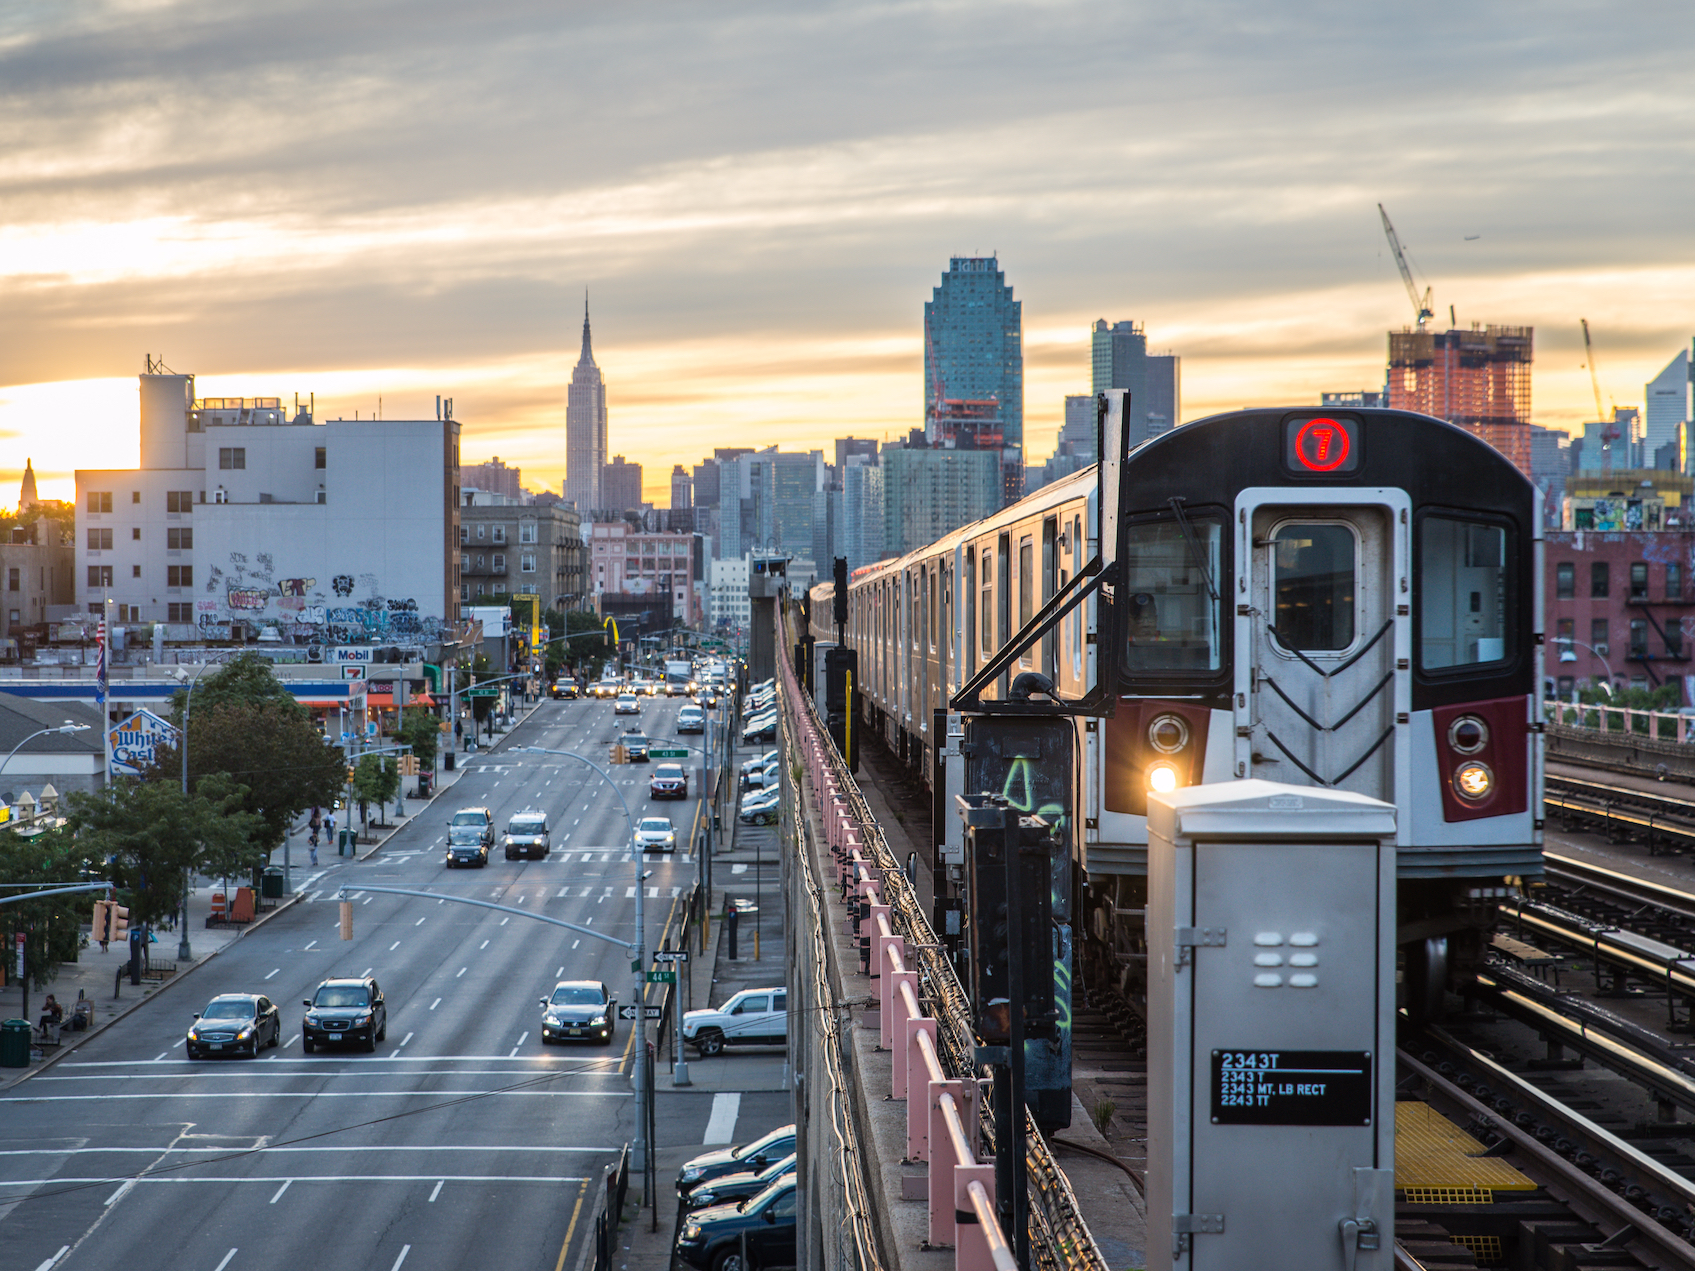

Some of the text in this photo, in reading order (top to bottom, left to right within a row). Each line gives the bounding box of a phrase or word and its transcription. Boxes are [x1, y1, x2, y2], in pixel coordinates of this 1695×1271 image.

[962, 260, 984, 272] citi
[1312, 429, 1333, 460] 7
[338, 650, 368, 660] Mobil
[113, 747, 154, 761] Cast
[652, 973, 663, 982] 44
[1221, 1071, 1265, 1083] 2343 T
[1221, 1083, 1326, 1096] 2343 MT. LB RECT
[1221, 1094, 1270, 1106] 2243 TT
